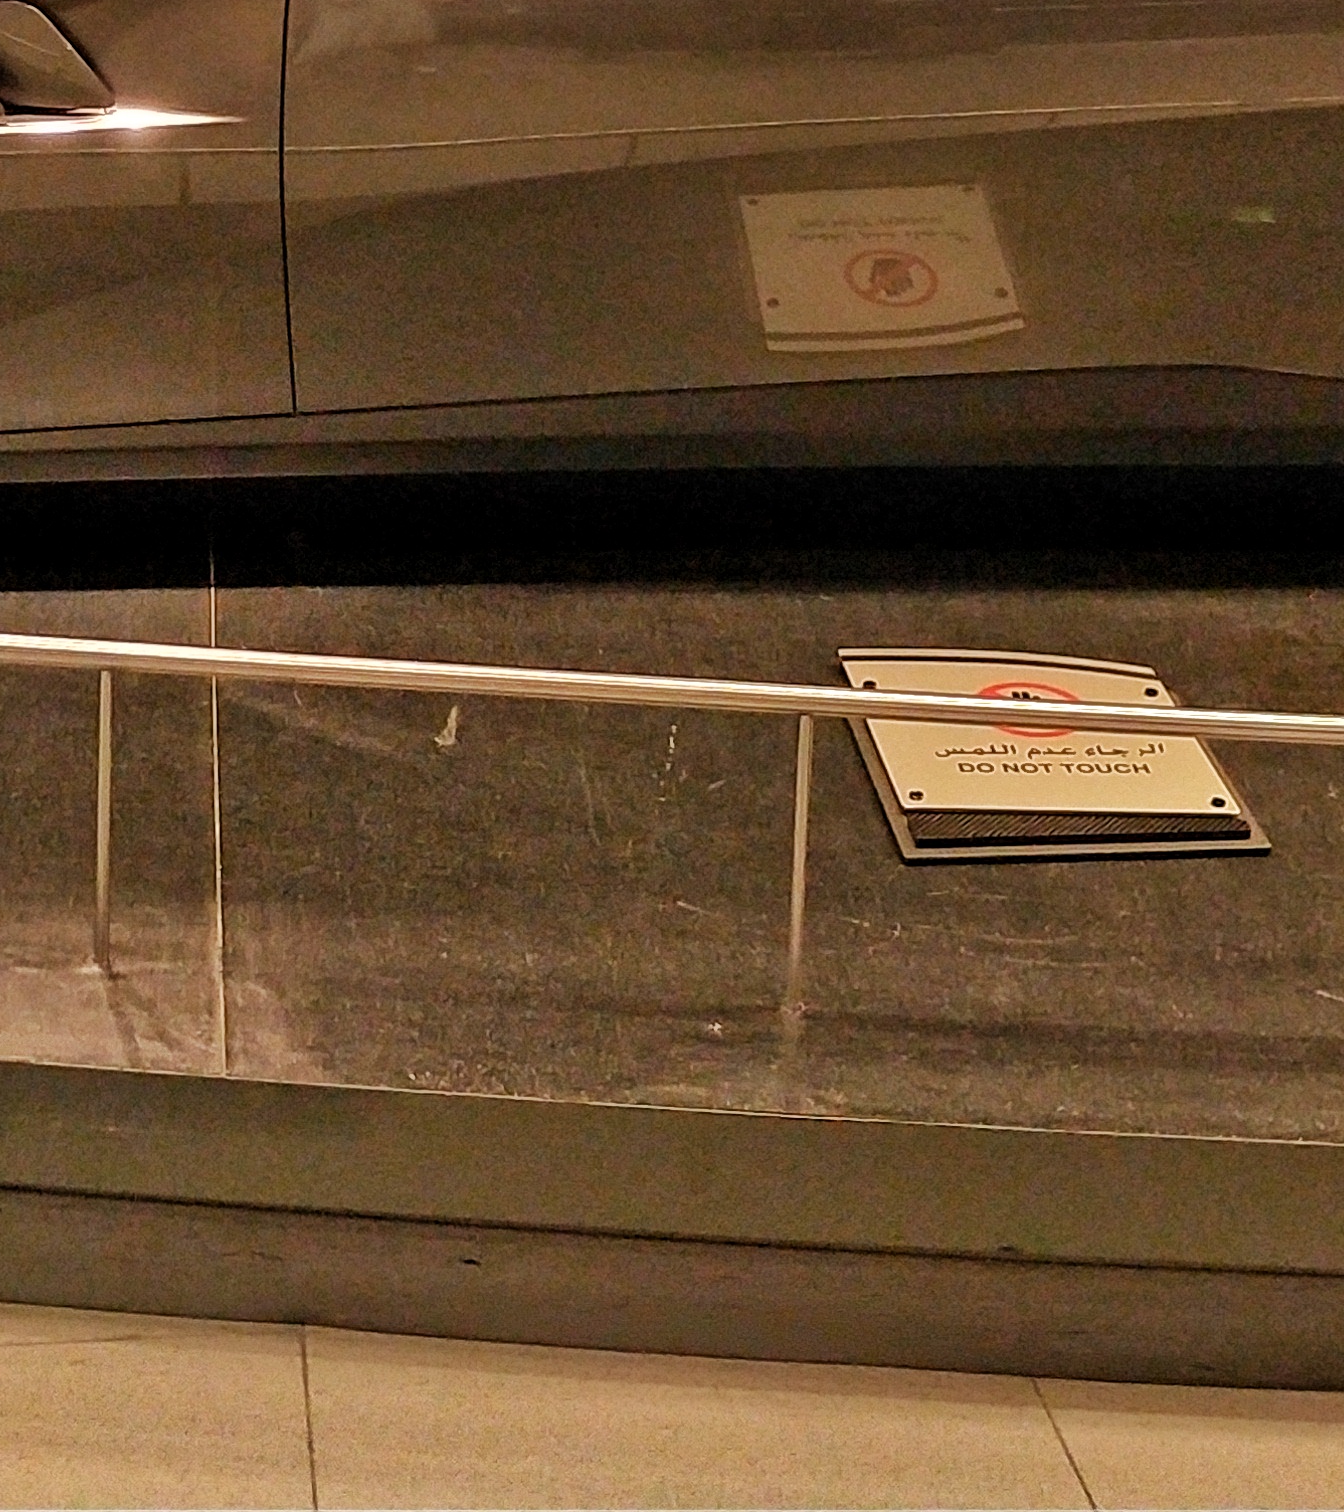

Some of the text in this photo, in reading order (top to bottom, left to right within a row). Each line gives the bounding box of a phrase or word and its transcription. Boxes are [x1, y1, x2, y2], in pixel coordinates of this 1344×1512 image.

[935, 743, 1165, 760] الرجاء عدم اللمس
[958, 762, 1151, 774] DO NOT TOUCH
